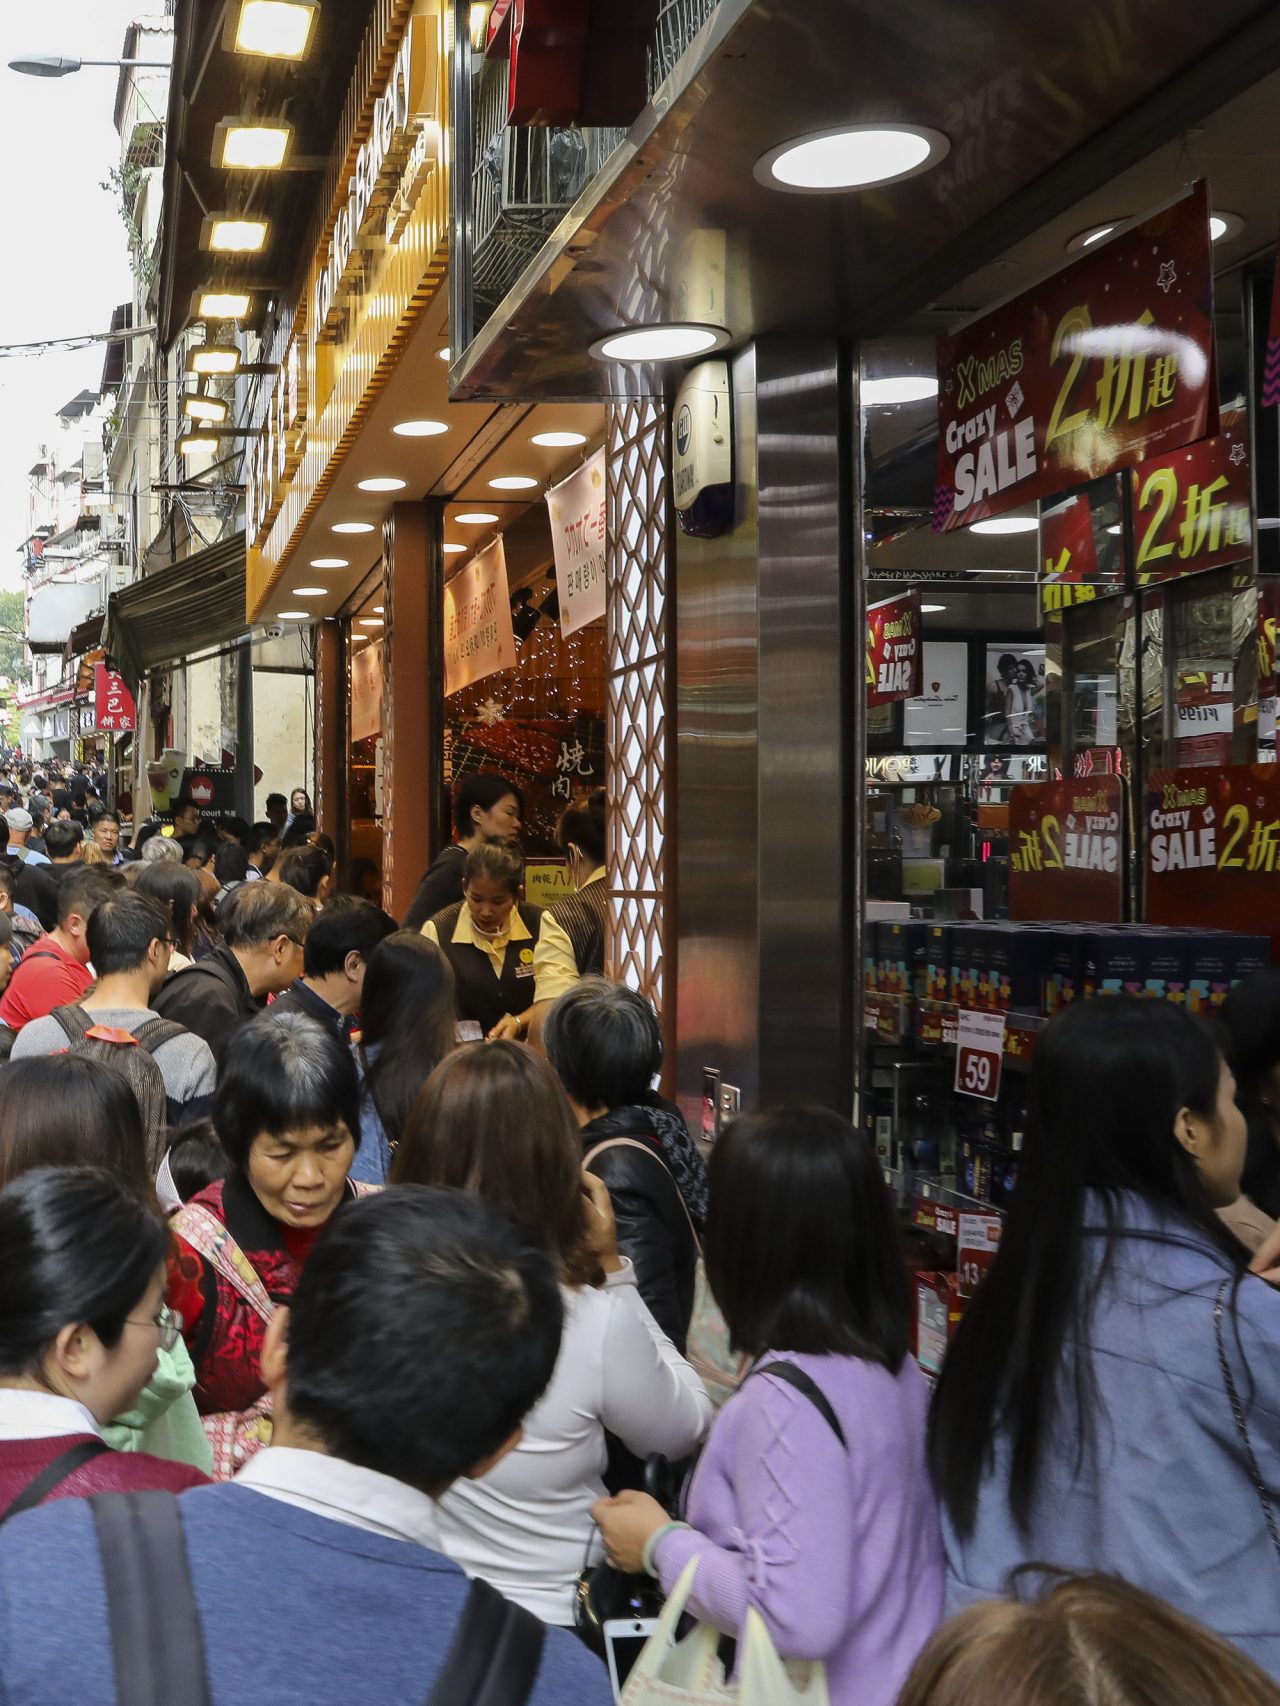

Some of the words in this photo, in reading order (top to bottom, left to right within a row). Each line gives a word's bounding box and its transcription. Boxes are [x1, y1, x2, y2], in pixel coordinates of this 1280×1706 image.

[355, 14, 413, 236] Bakery
[945, 403, 997, 454] Crazy
[953, 415, 1038, 512] SALE
[1150, 809, 1191, 830] Crazy
[1217, 803, 1280, 873] 2折
[1150, 827, 1217, 873] SALE
[964, 1054, 990, 1092] 59
